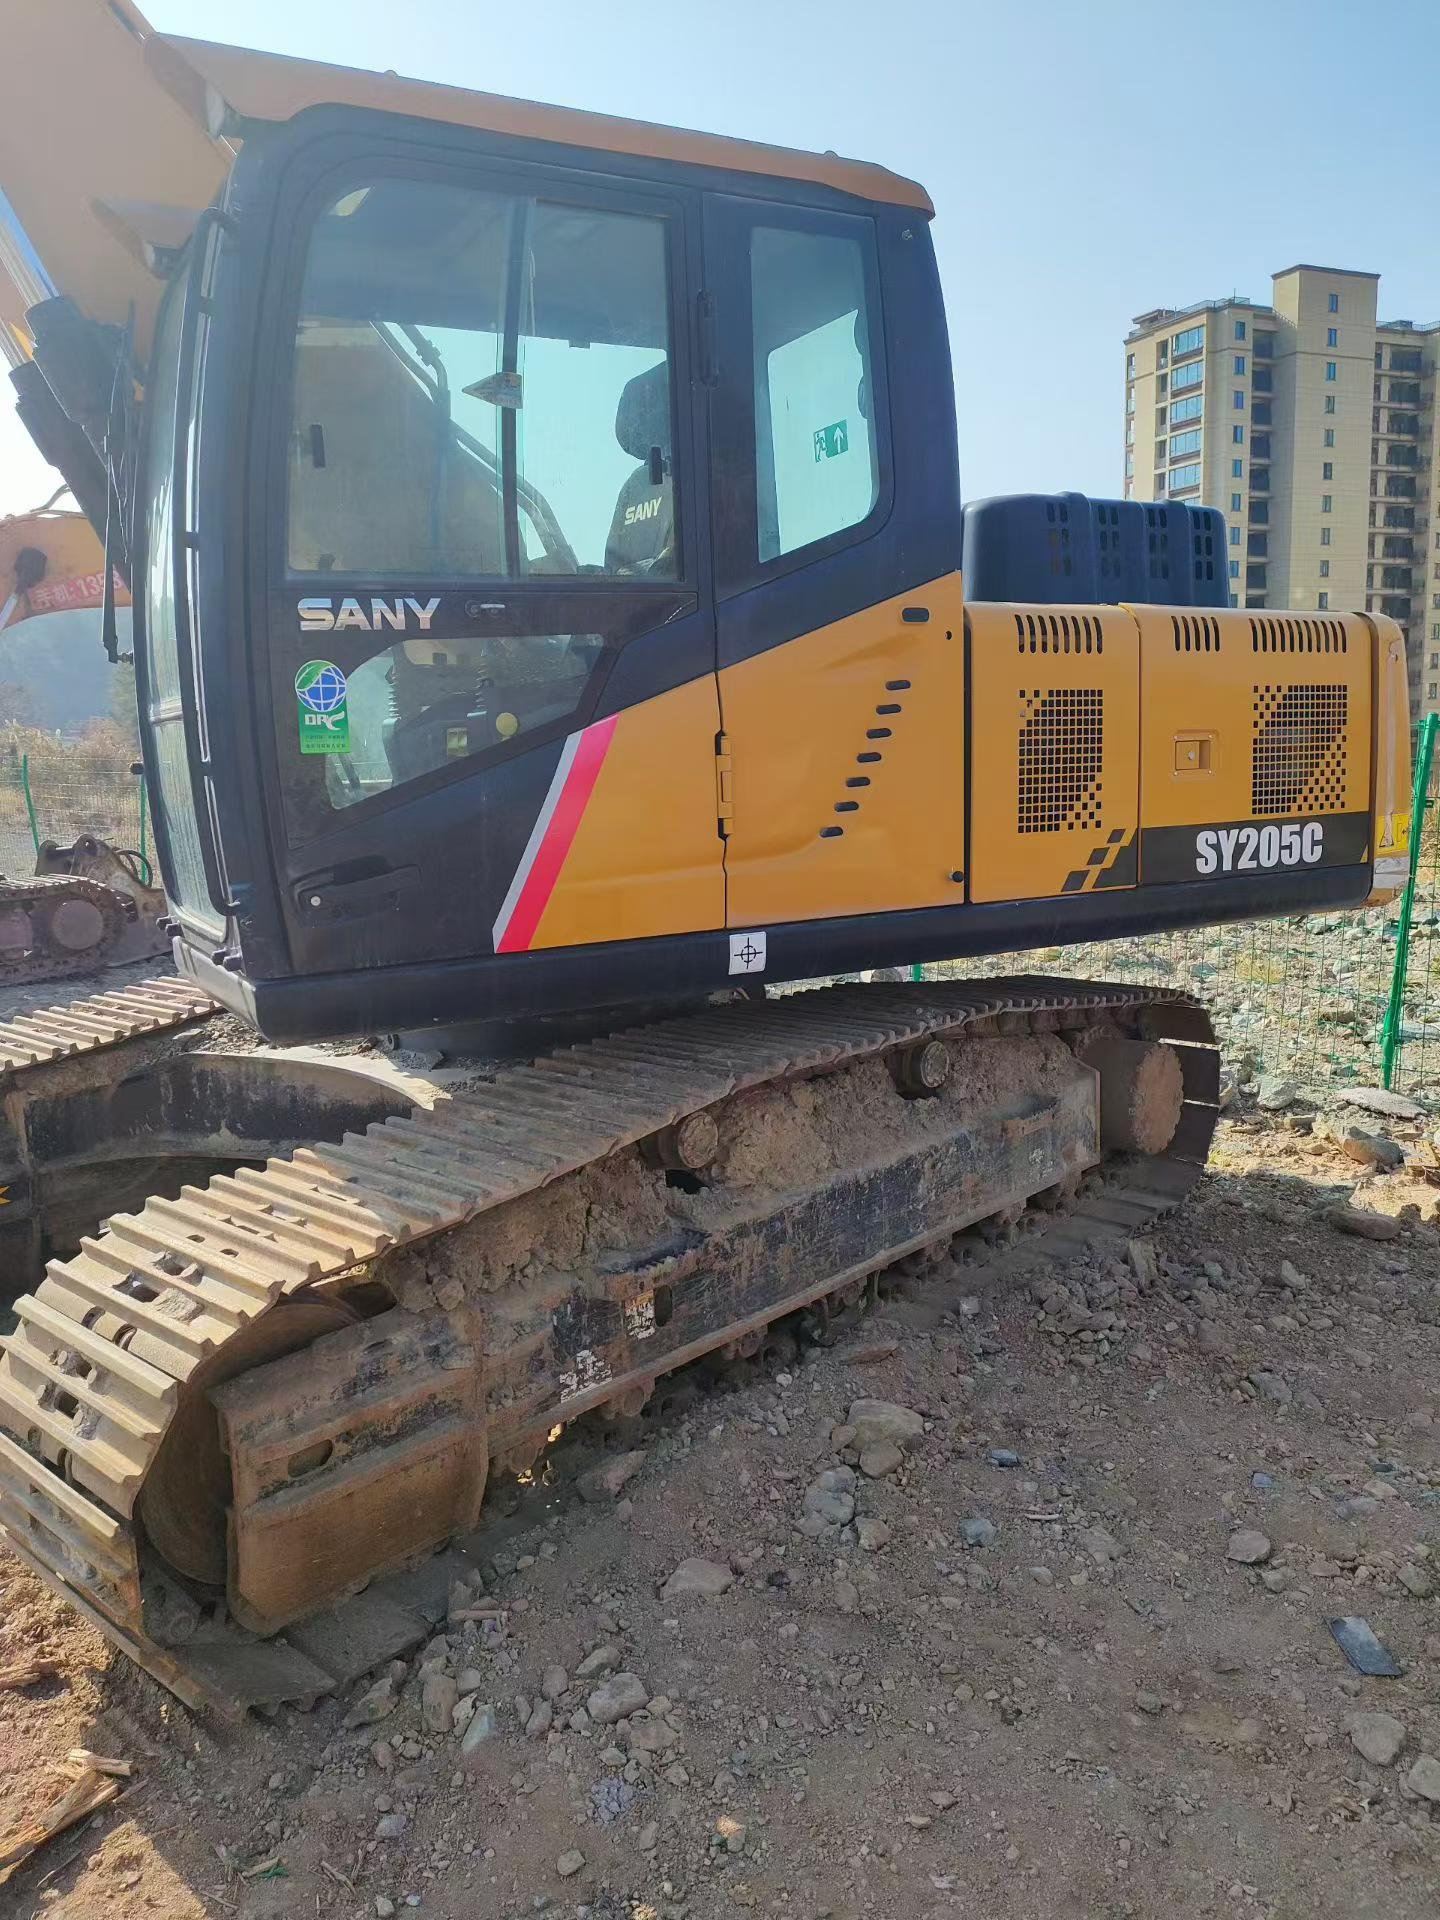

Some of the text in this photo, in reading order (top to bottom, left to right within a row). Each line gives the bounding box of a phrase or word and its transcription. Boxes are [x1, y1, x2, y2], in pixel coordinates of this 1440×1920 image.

[624, 497, 662, 526] SANY
[297, 597, 441, 631] SANY
[1195, 821, 1324, 874] SY205C
